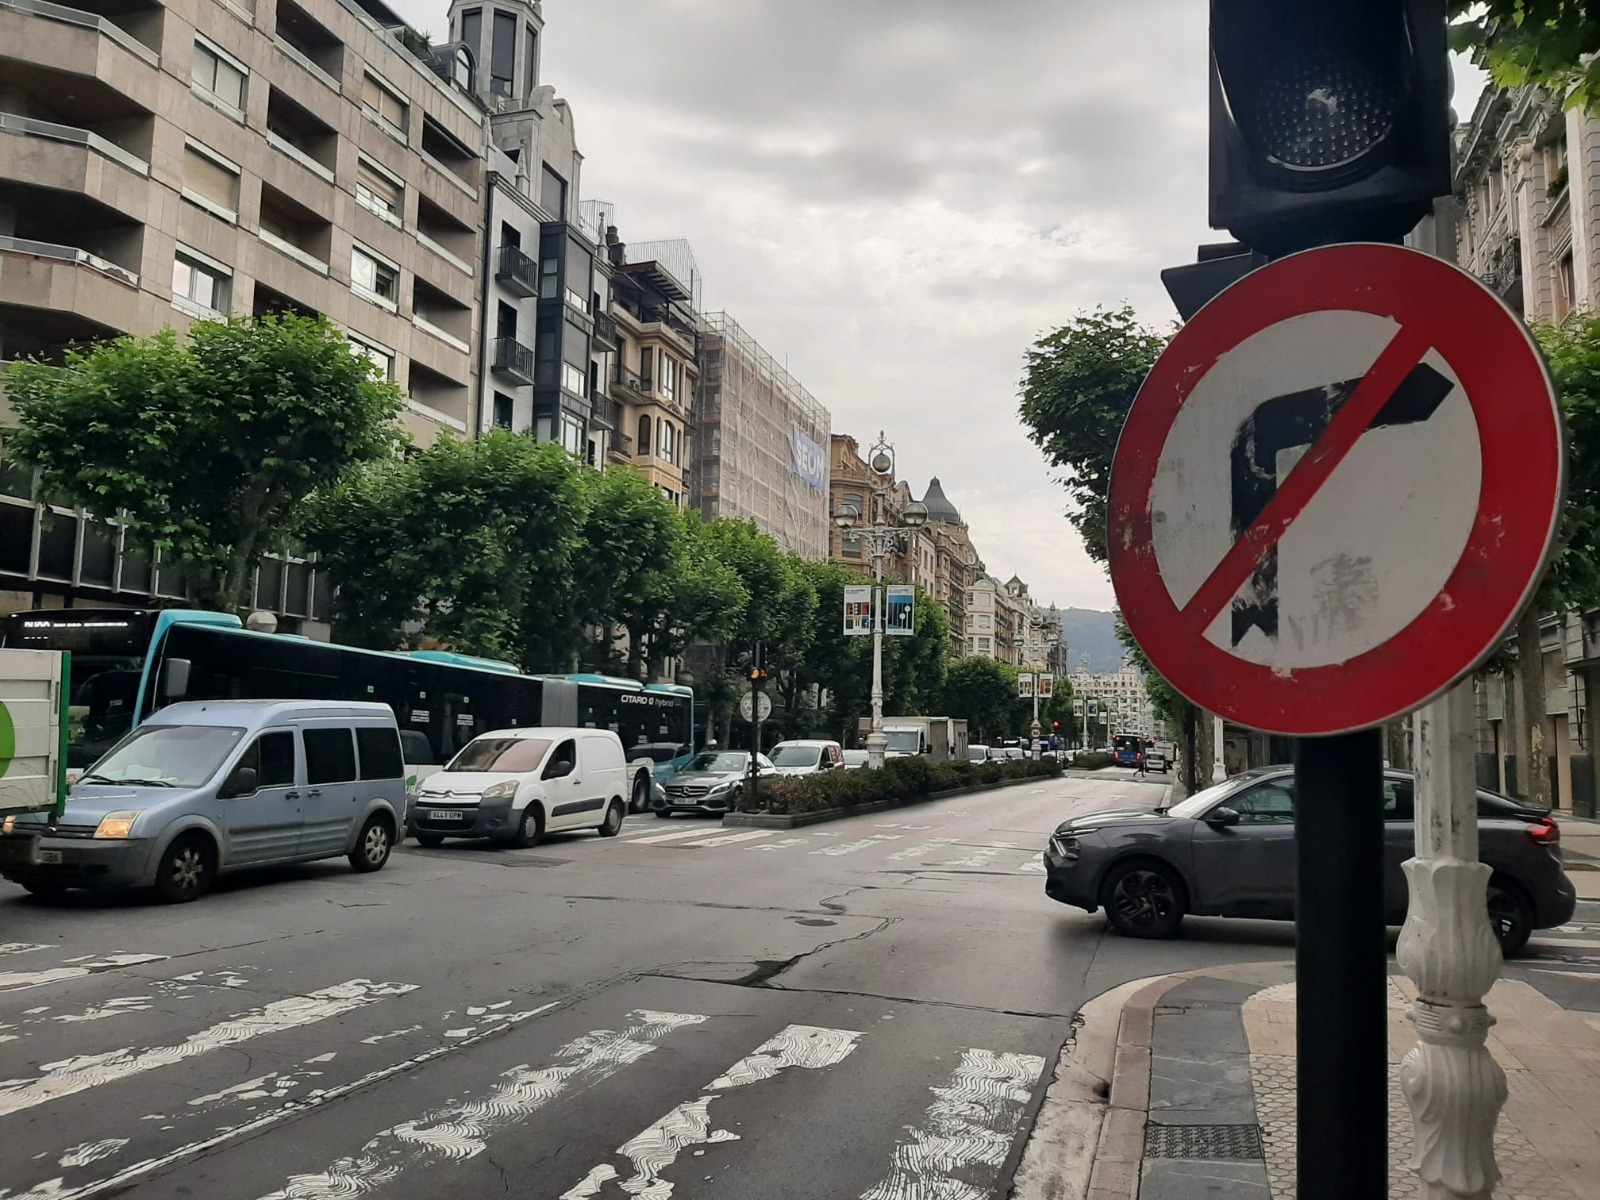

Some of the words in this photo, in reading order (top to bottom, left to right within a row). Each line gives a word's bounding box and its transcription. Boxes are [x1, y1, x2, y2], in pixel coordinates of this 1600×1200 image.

[621, 694, 647, 705] CITARO
[648, 697, 655, 705] G
[655, 698, 674, 708] hybrid
